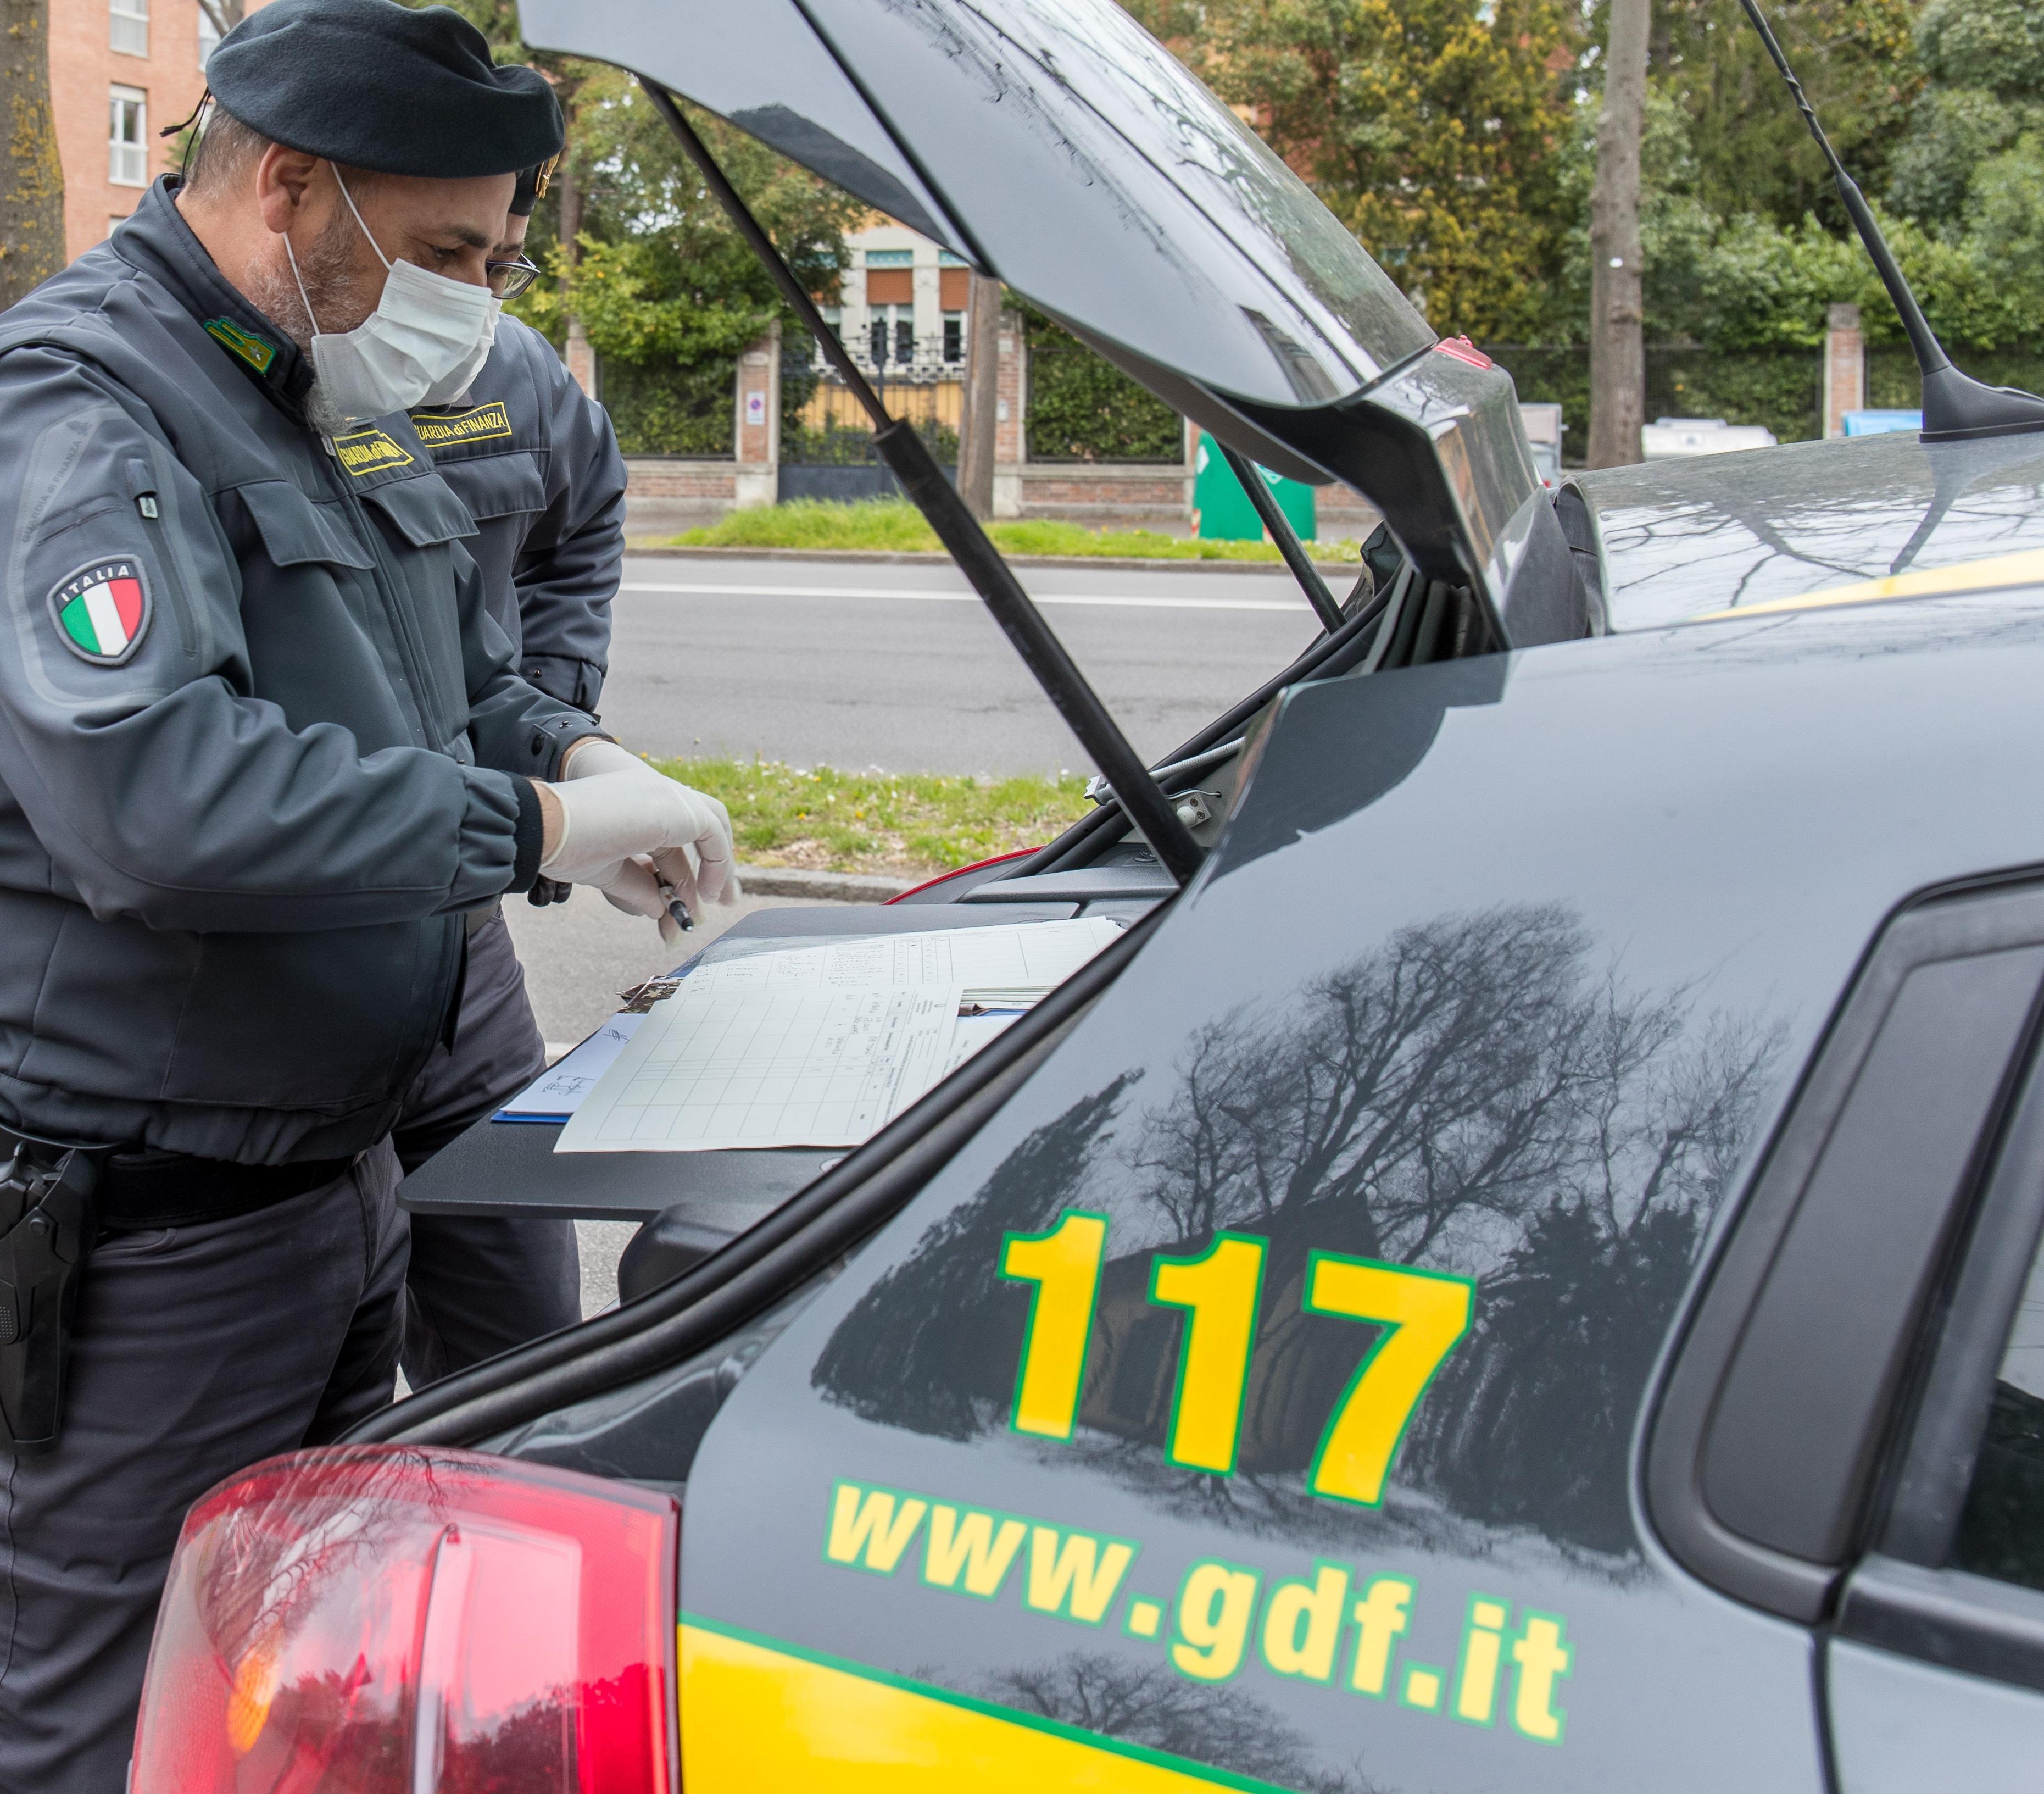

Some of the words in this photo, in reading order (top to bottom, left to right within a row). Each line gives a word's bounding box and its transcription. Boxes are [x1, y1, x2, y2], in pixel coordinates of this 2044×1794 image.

[413, 424, 455, 440] UARDIA
[453, 424, 465, 435] di
[460, 412, 506, 433] FINANZA
[61, 565, 130, 602] ITALIA
[997, 1208, 1478, 1509] 117
[822, 1476, 1574, 1746] www.gdf.it
